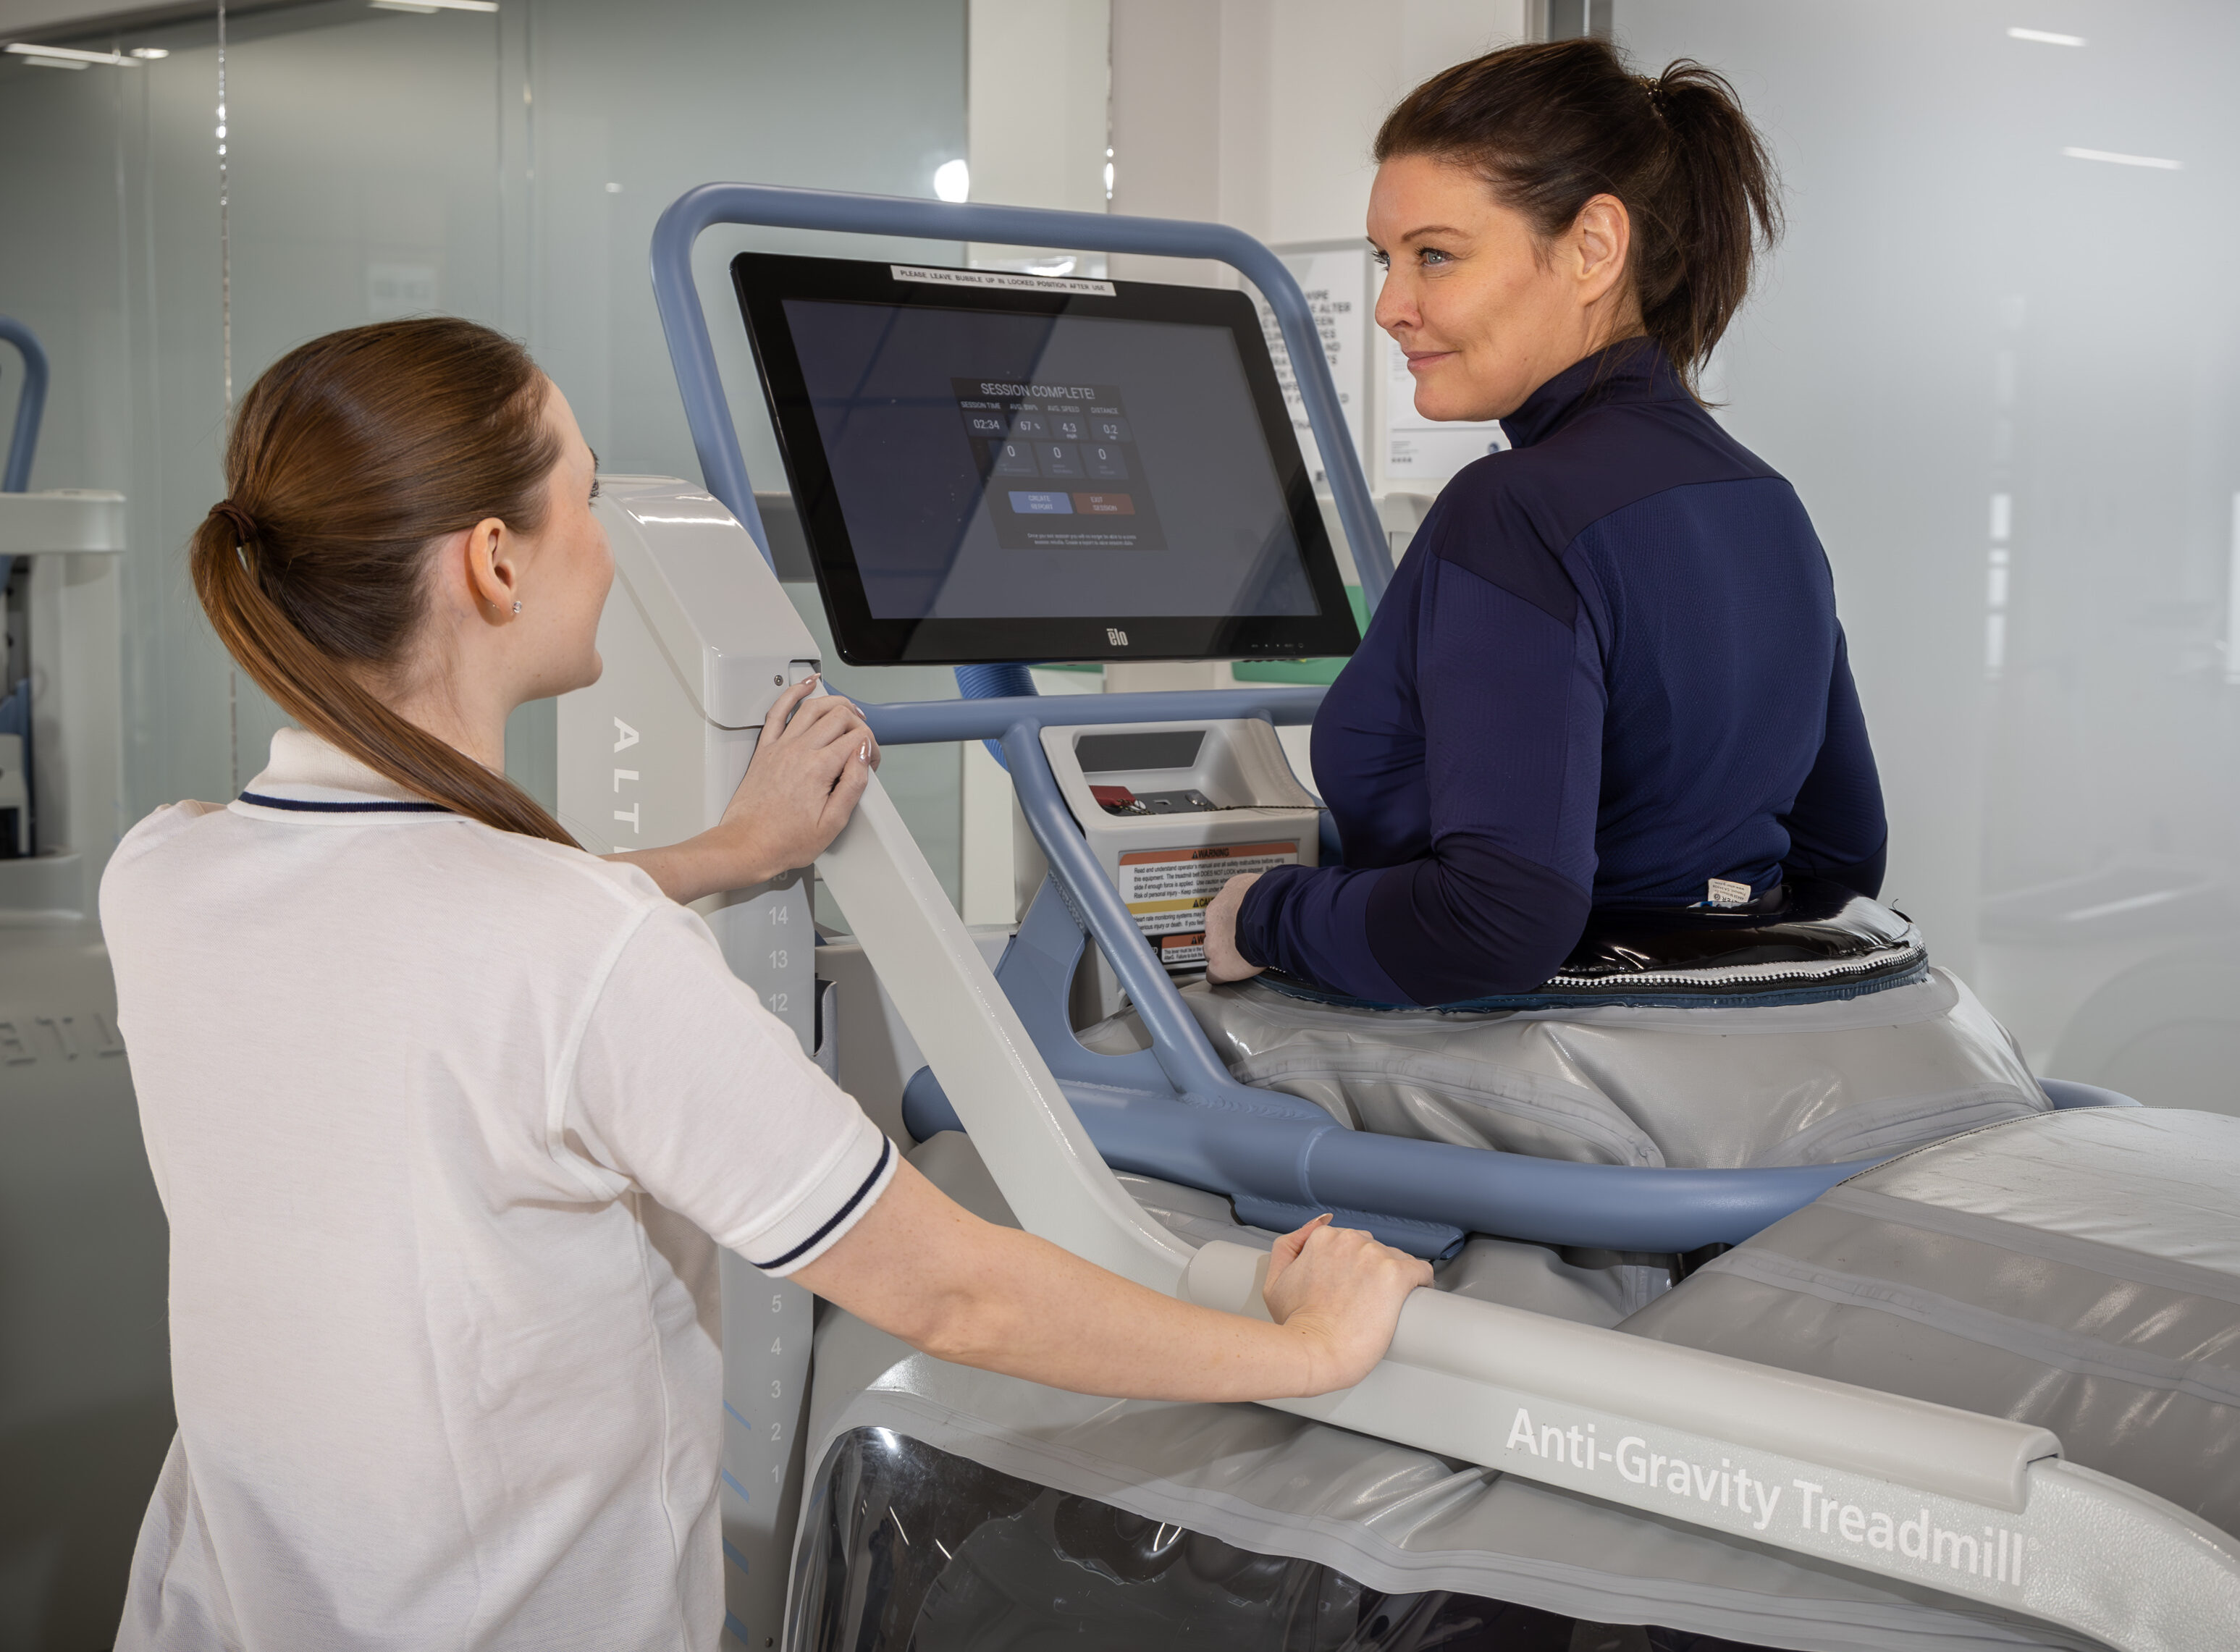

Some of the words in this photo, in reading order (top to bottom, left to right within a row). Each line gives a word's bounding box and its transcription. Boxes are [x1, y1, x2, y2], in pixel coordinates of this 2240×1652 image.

[900, 269, 927, 279] PLEASE
[930, 272, 952, 281] LEAVE
[955, 274, 982, 283] BUBBLE
[1007, 279, 1035, 287] LOCKED
[1037, 280, 1066, 289] POSITION
[980, 382, 1030, 397] SESSION
[1031, 385, 1095, 400] COMPLETE!
[973, 418, 1000, 429] 02:34
[1062, 422, 1077, 432] 4.3
[1103, 424, 1118, 434] 0.2
[1007, 445, 1015, 458] 0
[1053, 447, 1061, 458] 0
[1098, 448, 1106, 460] 0
[613, 717, 639, 854] ALT
[1198, 848, 1229, 858] WARNING
[769, 906, 788, 925] 14
[769, 950, 788, 969] 13
[769, 993, 788, 1012] 12
[771, 1295, 782, 1312] 5
[771, 1338, 782, 1355] 4
[771, 1381, 782, 1398] 3
[771, 1423, 782, 1441] 2
[771, 1466, 779, 1483] 1
[1506, 1407, 1782, 1530] Anti-Gravity
